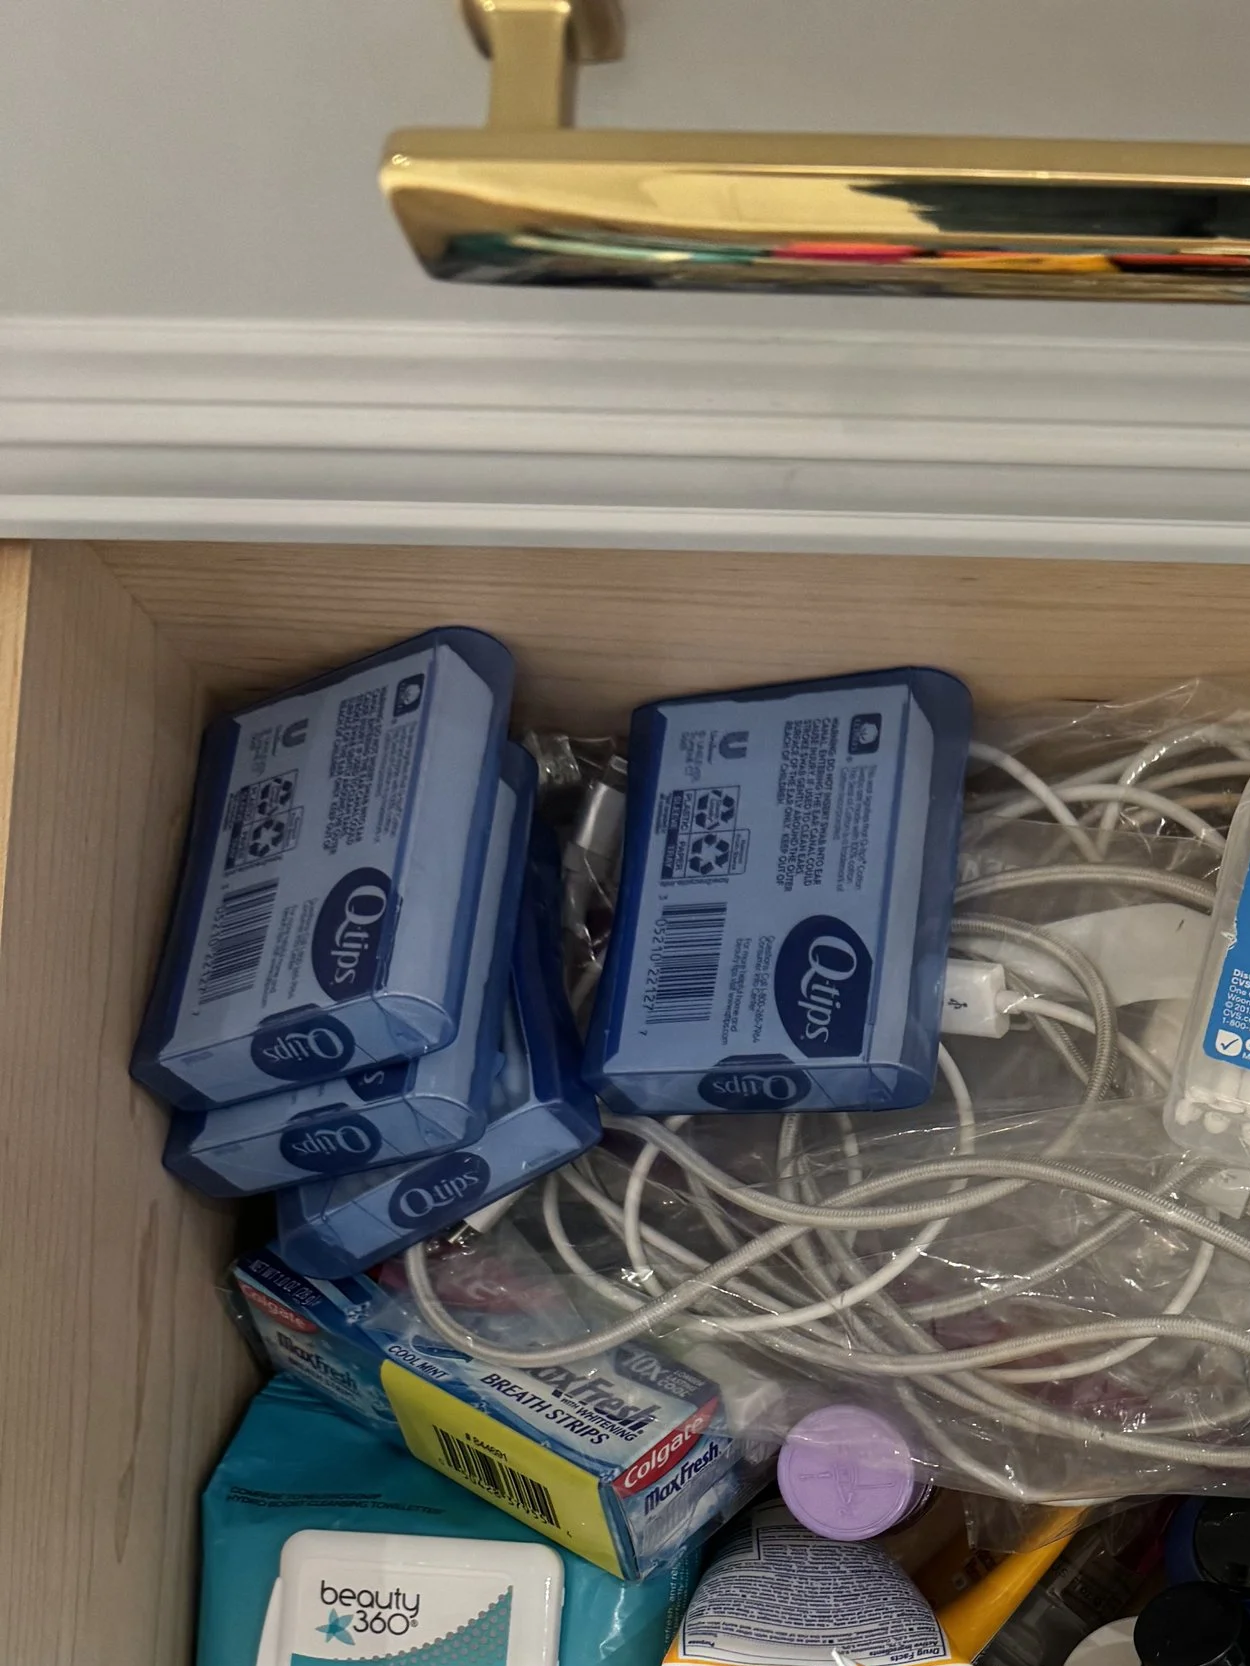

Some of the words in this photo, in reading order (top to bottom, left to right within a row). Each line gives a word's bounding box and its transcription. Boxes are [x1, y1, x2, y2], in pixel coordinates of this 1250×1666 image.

[329, 886, 386, 987] Q-tips
[799, 934, 859, 1043] Q-tips
[713, 1072, 797, 1101] Q-tips
[399, 1167, 482, 1209] Q-tips
[387, 1343, 420, 1367] COOL
[417, 1359, 450, 1383] MINT
[479, 1369, 547, 1414] BREATH
[544, 1404, 611, 1449] STRIPS
[575, 1404, 638, 1444] WHITENING
[618, 1417, 706, 1488] Colgate
[319, 1580, 421, 1618] beauty
